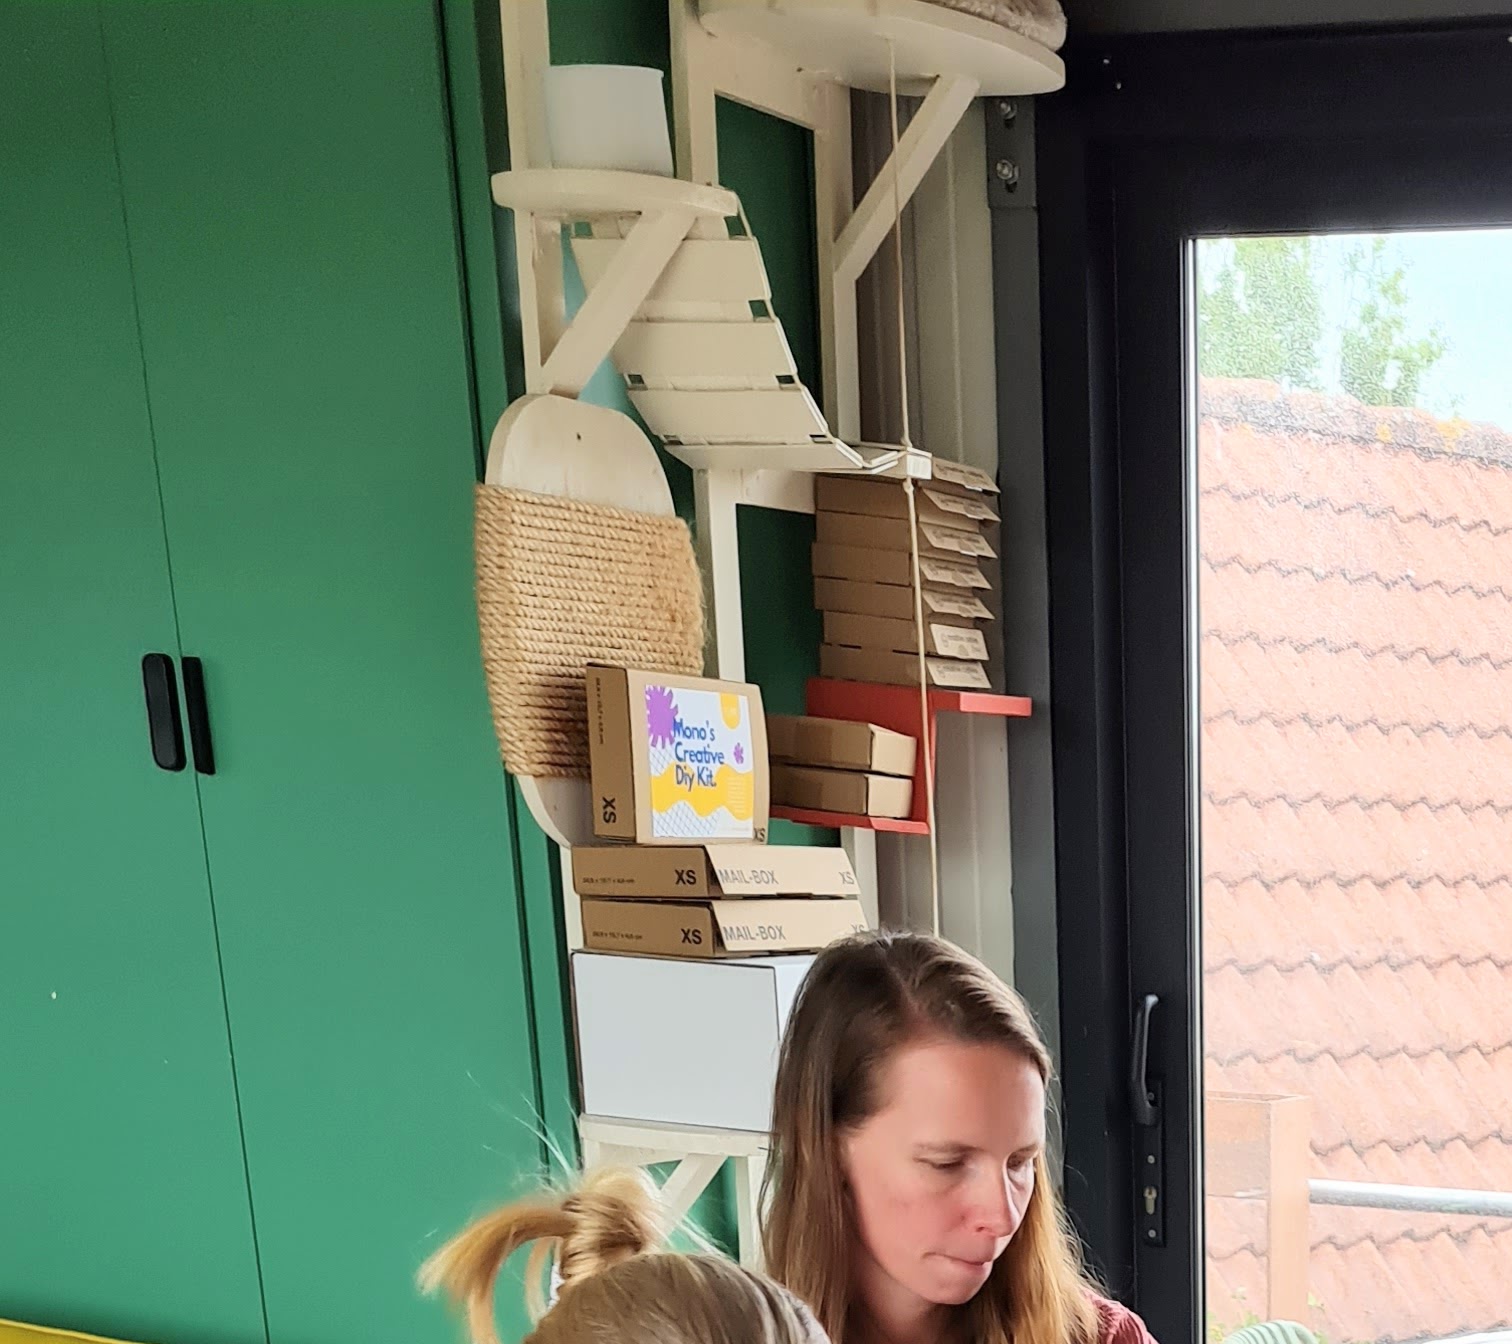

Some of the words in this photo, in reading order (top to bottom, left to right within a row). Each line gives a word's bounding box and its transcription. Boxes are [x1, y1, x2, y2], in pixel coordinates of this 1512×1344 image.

[673, 717, 716, 742] Mono's
[674, 741, 725, 765] Creative
[675, 764, 695, 792] Diy
[697, 766, 717, 787] Kit.
[602, 796, 617, 824] XS
[674, 869, 697, 885] XS
[718, 869, 779, 885] MAIL-BOX
[838, 871, 855, 885] XS
[681, 928, 703, 945] XS
[722, 926, 786, 942] MAIL-BOX
